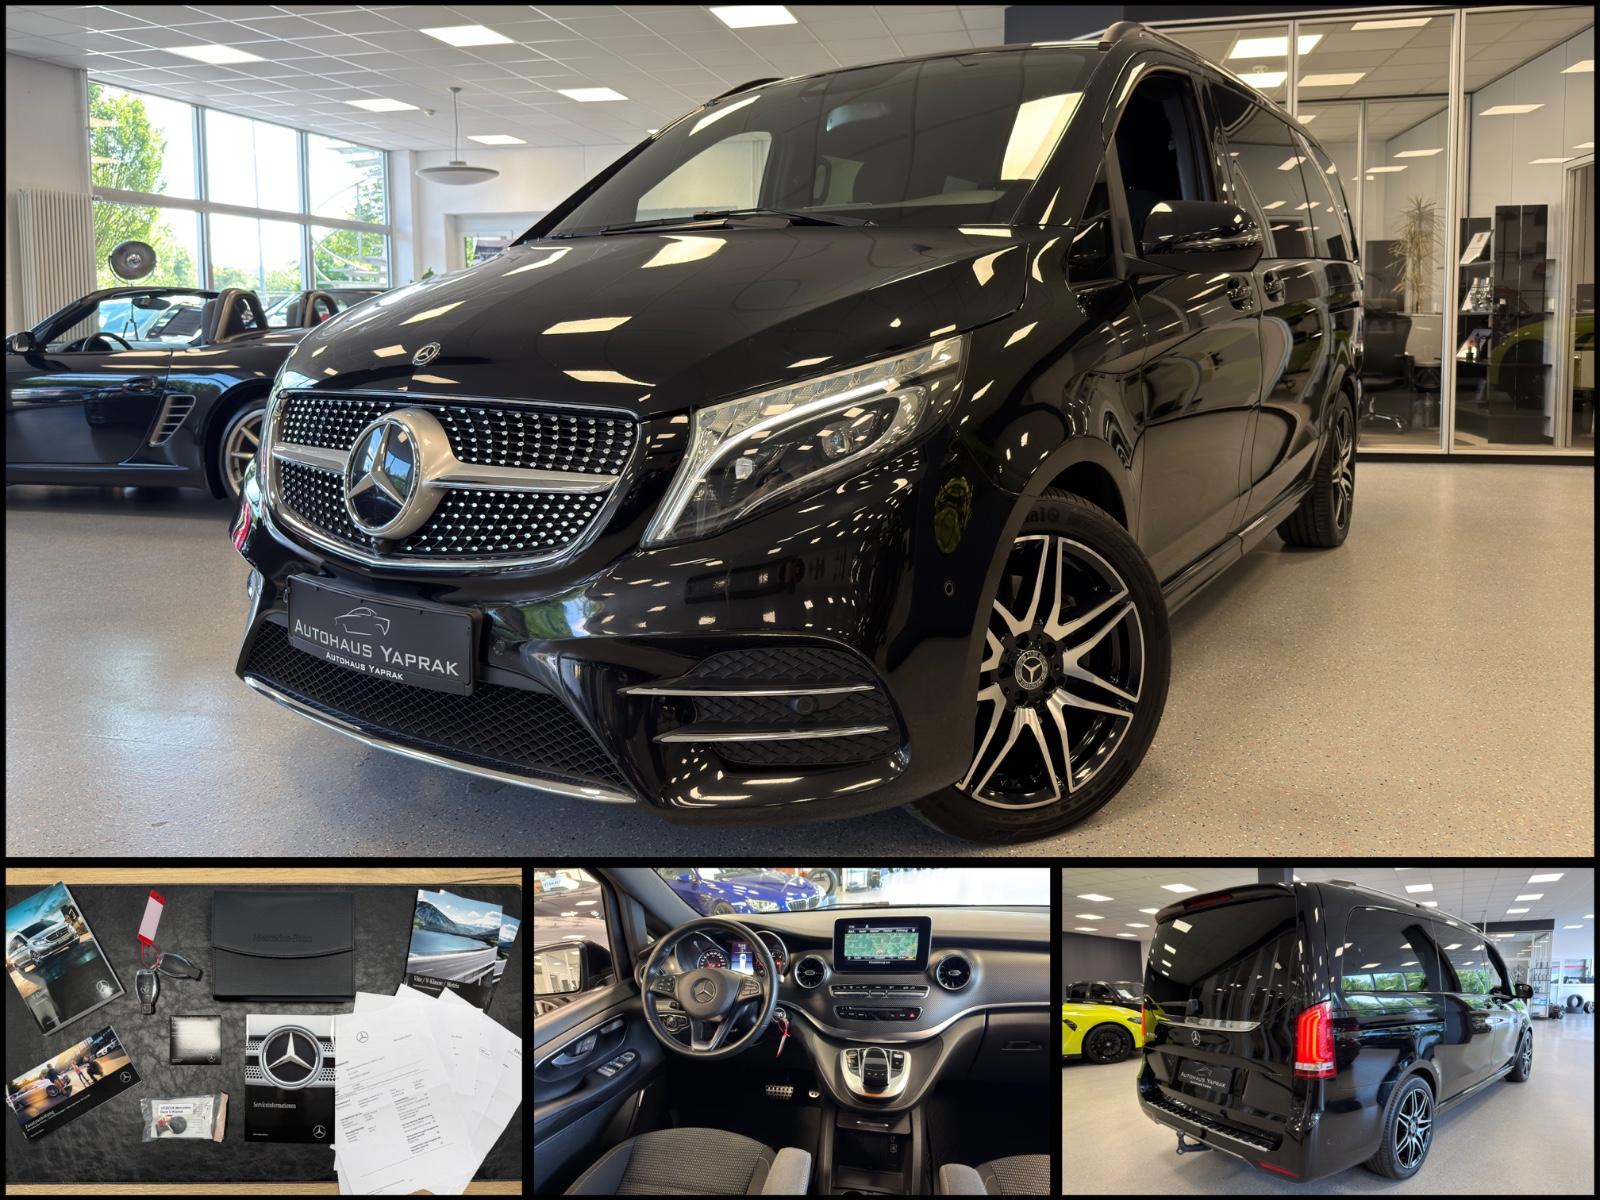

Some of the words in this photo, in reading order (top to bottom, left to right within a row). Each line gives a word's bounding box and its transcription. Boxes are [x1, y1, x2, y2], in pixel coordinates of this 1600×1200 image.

[294, 619, 373, 658] AUTOHAUS
[380, 645, 459, 677] YAPRAK
[326, 651, 366, 671] AUTOHAUS
[368, 664, 404, 681] YAPRAK
